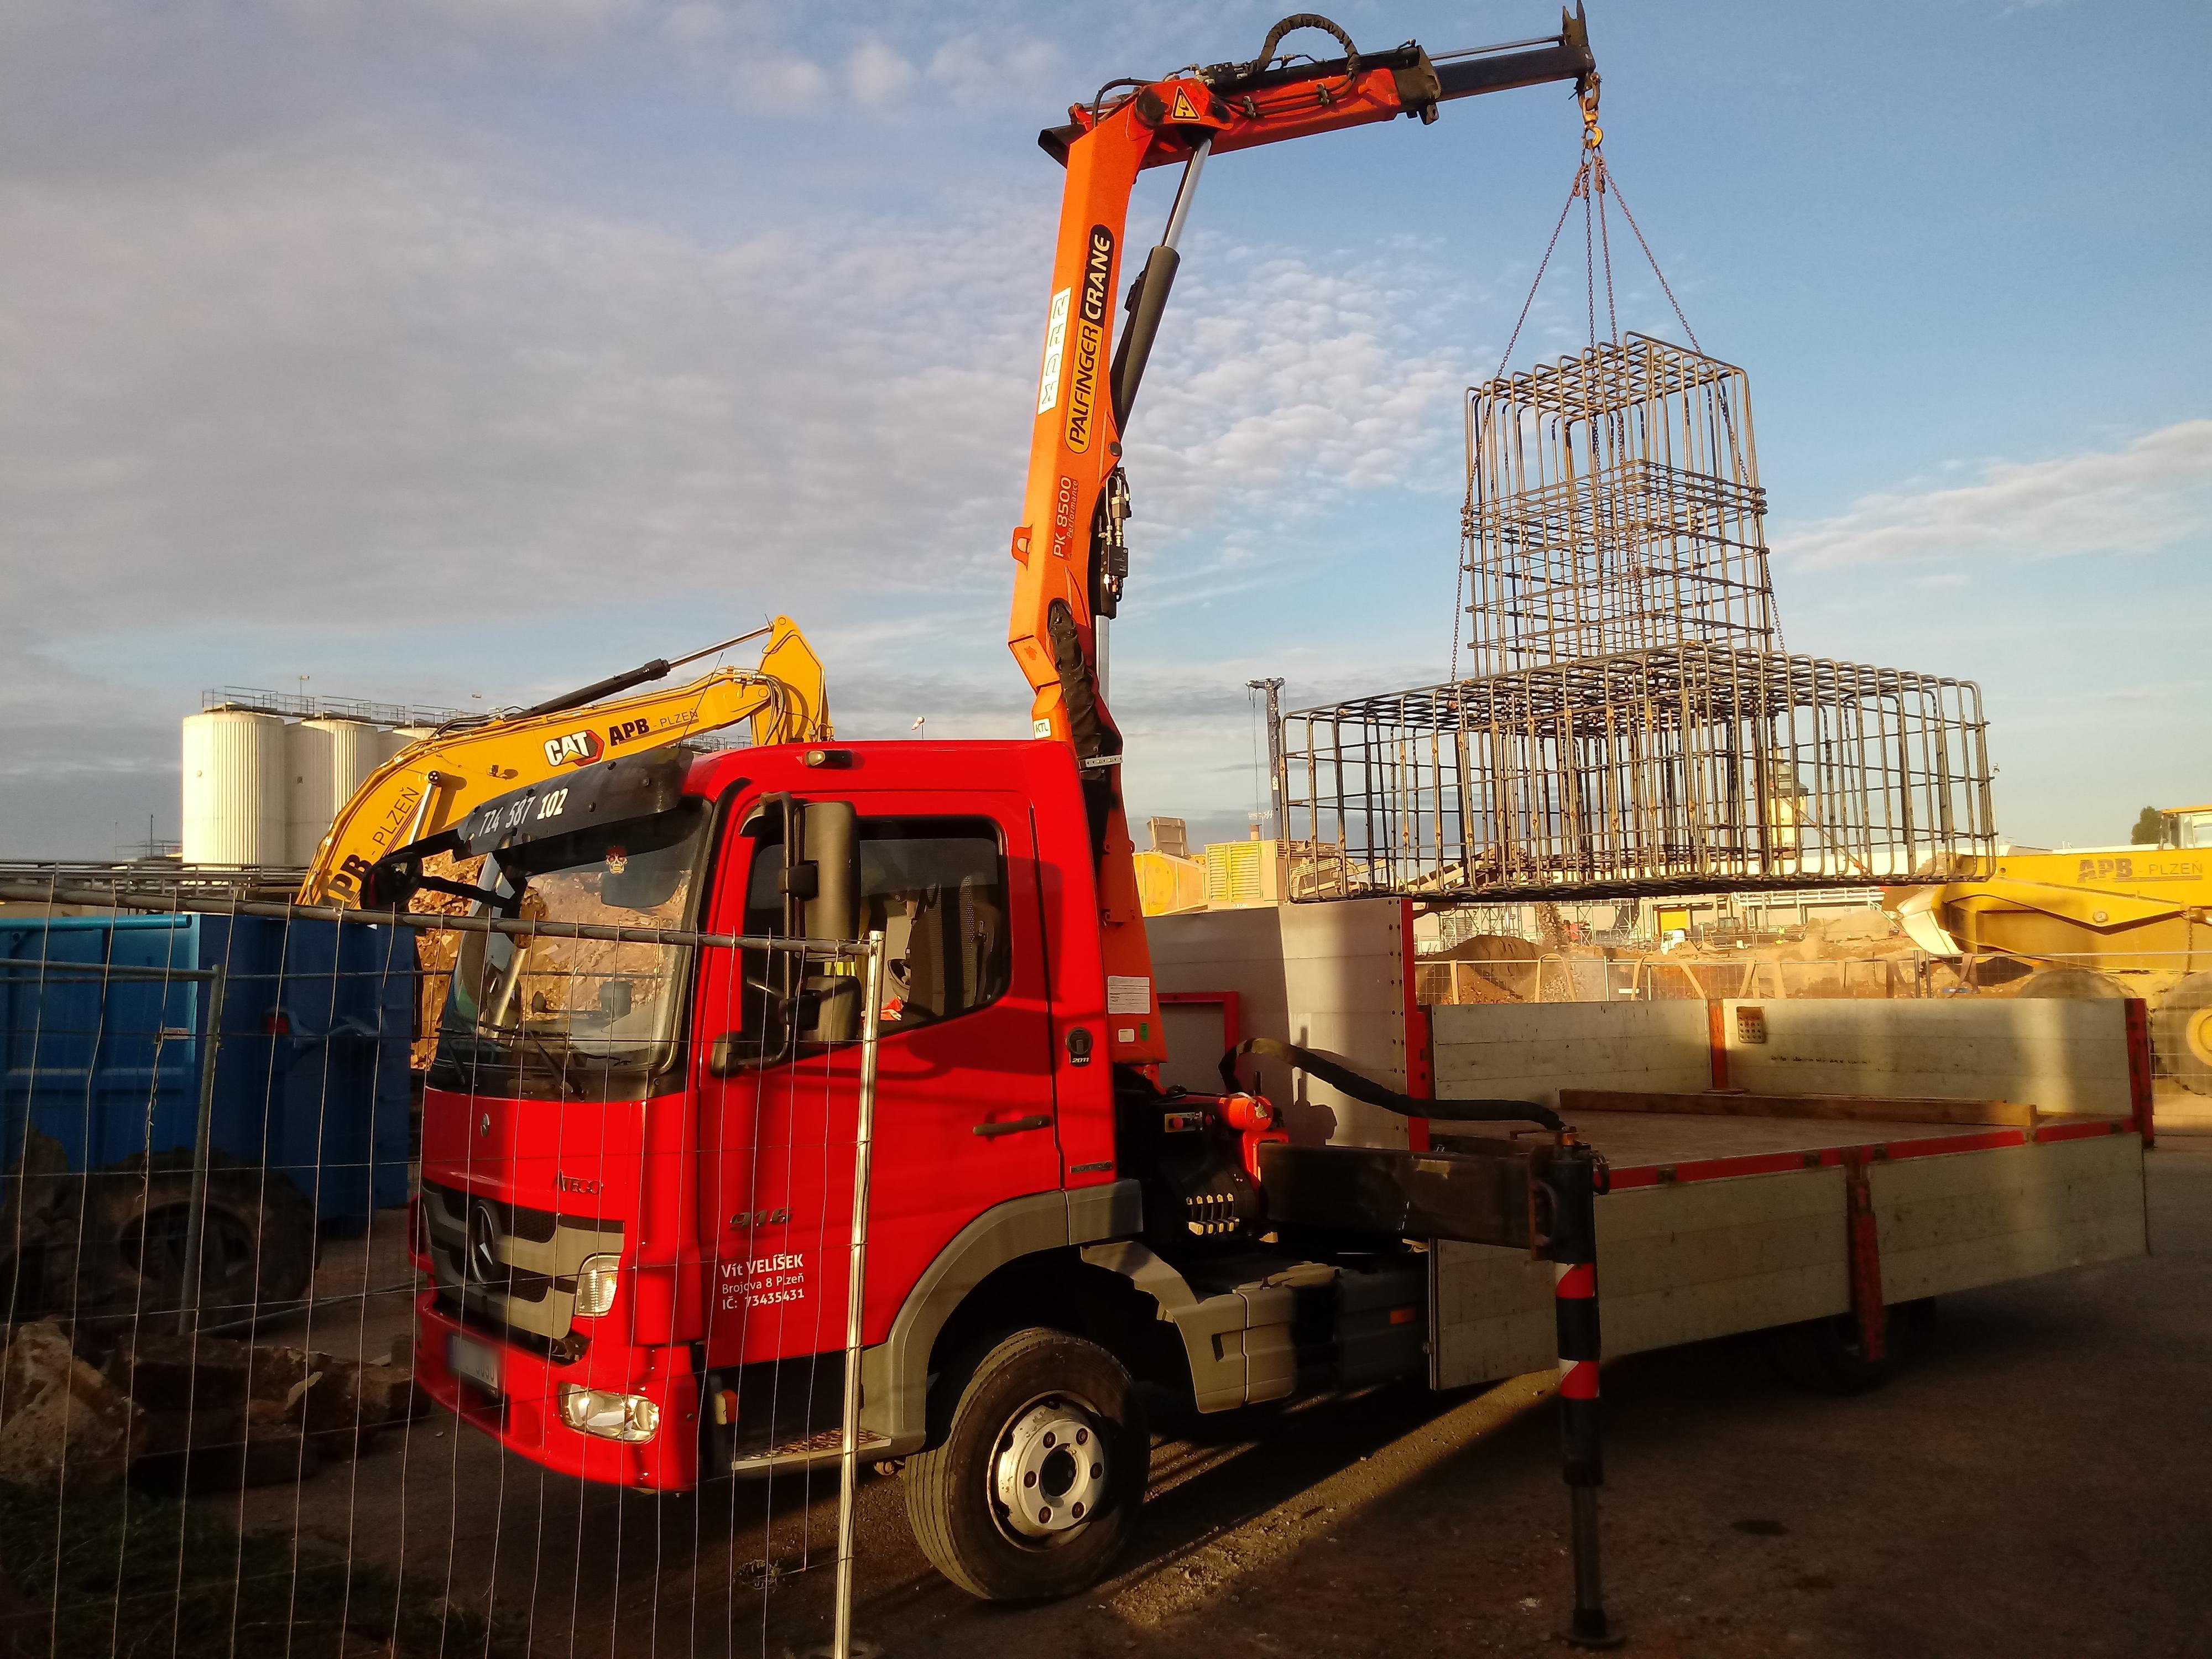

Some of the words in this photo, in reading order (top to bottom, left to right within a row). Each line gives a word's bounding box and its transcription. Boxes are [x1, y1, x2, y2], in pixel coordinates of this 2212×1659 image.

[1070, 325, 1098, 445] PALFINGER
[1085, 234, 1110, 320] CRANE
[1057, 477, 1071, 528] 8500
[1066, 480, 1078, 539] Performance
[1053, 533, 1066, 557] PK
[608, 718, 650, 747] APB
[660, 708, 698, 727] PLZEŇ
[544, 731, 590, 766] CAT
[478, 807, 504, 837] 724
[505, 796, 536, 828] 587
[537, 788, 568, 820] 102
[321, 854, 372, 907] PB
[372, 787, 420, 846] PLZEŇ
[2077, 858, 2133, 884] APB
[2149, 860, 2203, 875] PLZEŇ
[730, 1207, 792, 1230] 916
[721, 1263, 743, 1278] Vít
[747, 1253, 804, 1274] VELÍŠEK
[722, 1281, 762, 1294] Brojova
[766, 1277, 772, 1288] 8
[723, 1296, 738, 1310] IČ:
[745, 1288, 805, 1307] 73435431
